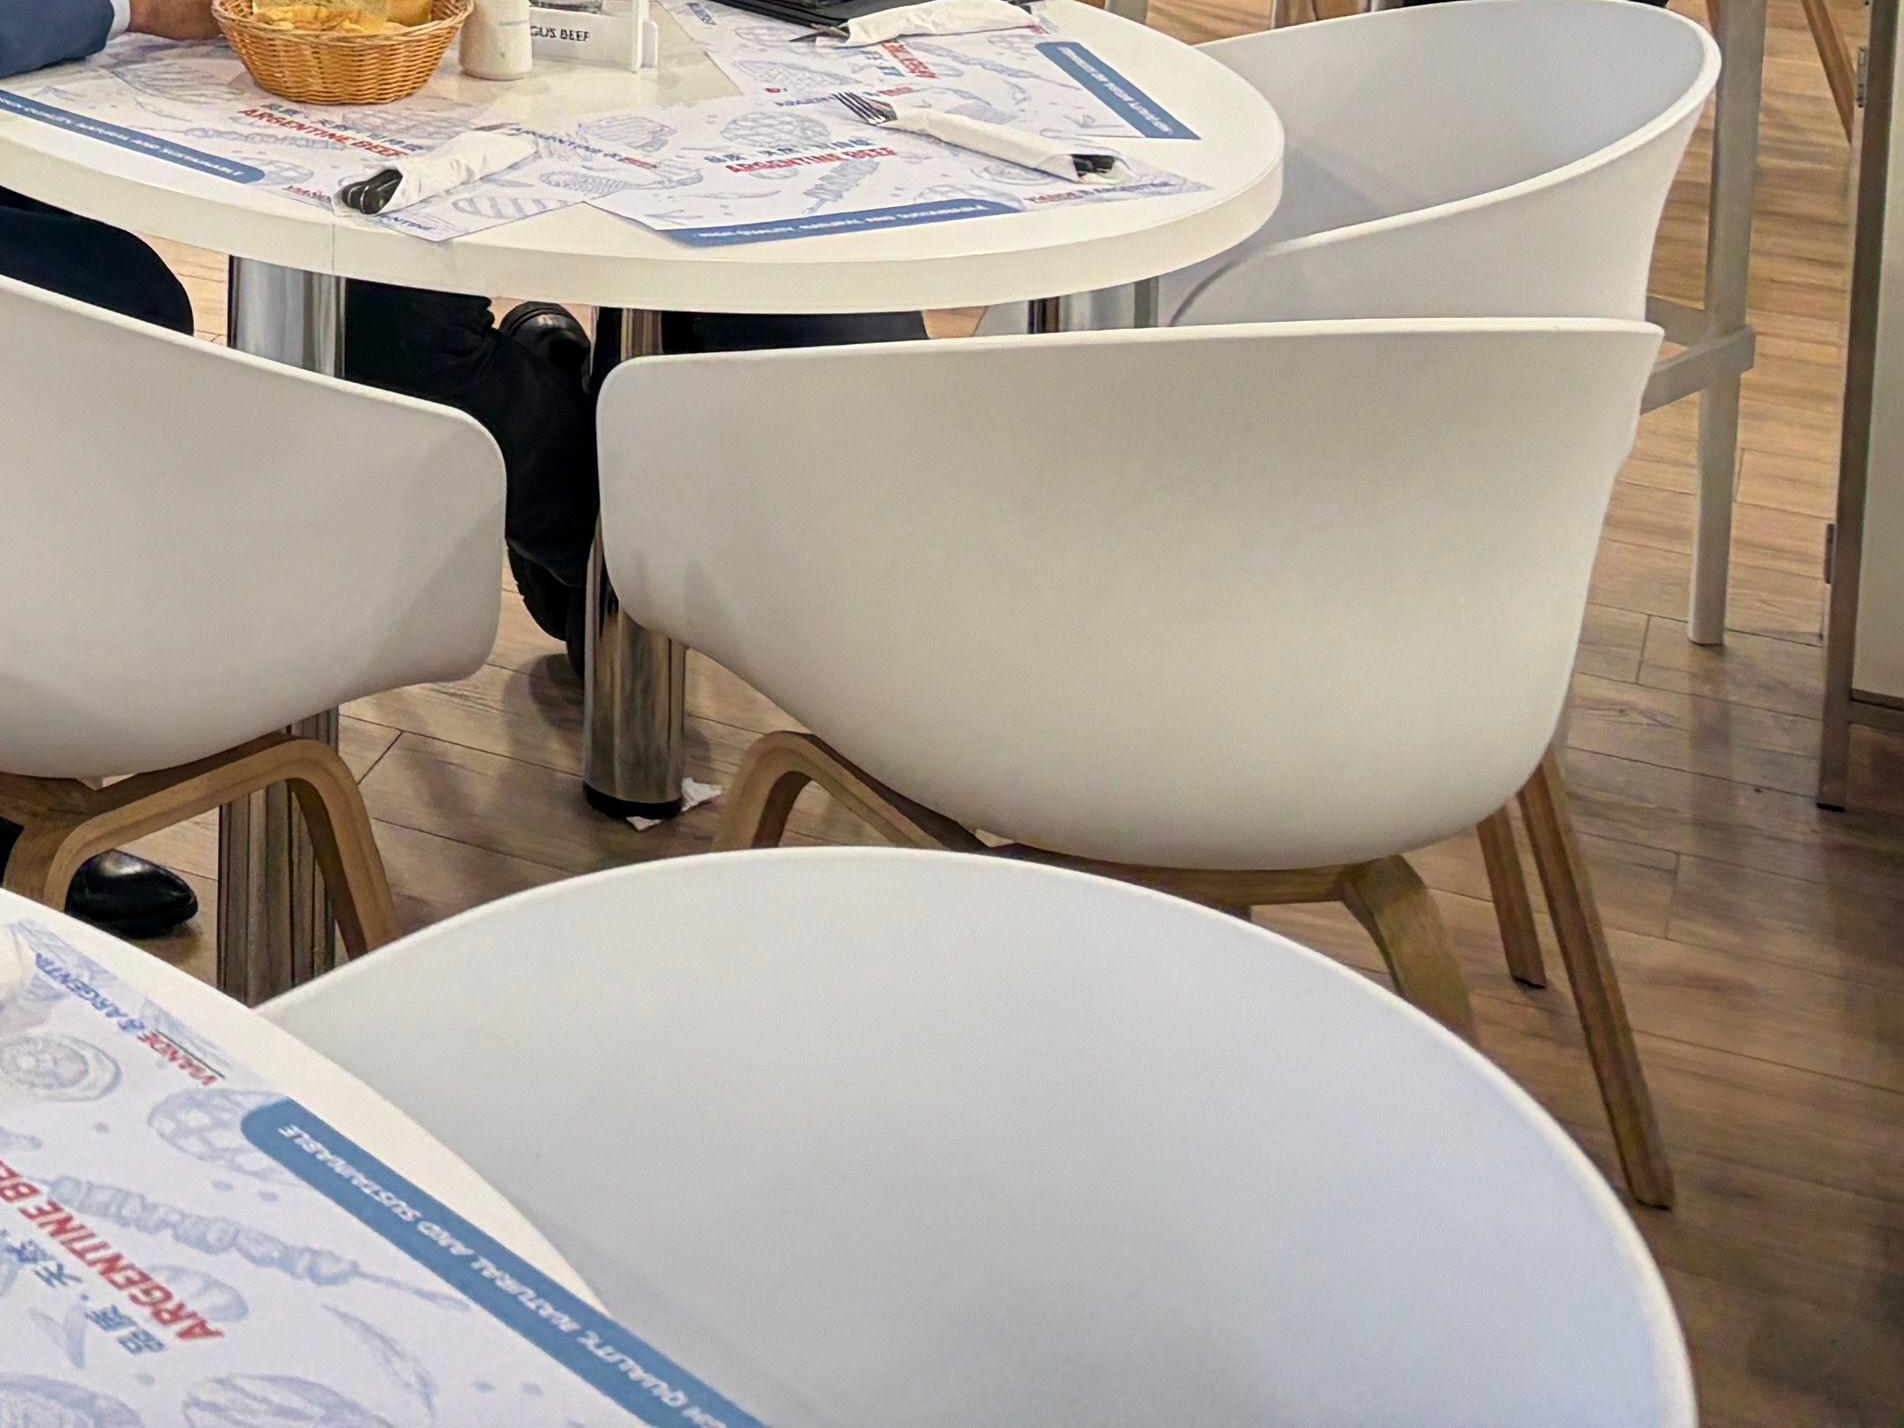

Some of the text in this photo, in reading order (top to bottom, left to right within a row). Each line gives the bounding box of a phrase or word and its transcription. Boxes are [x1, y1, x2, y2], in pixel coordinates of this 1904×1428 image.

[529, 25, 558, 39] GUS
[238, 108, 356, 144] ARGENTINE
[351, 139, 409, 158] BEEF
[18, 1197, 225, 1341] ARGENTINE
